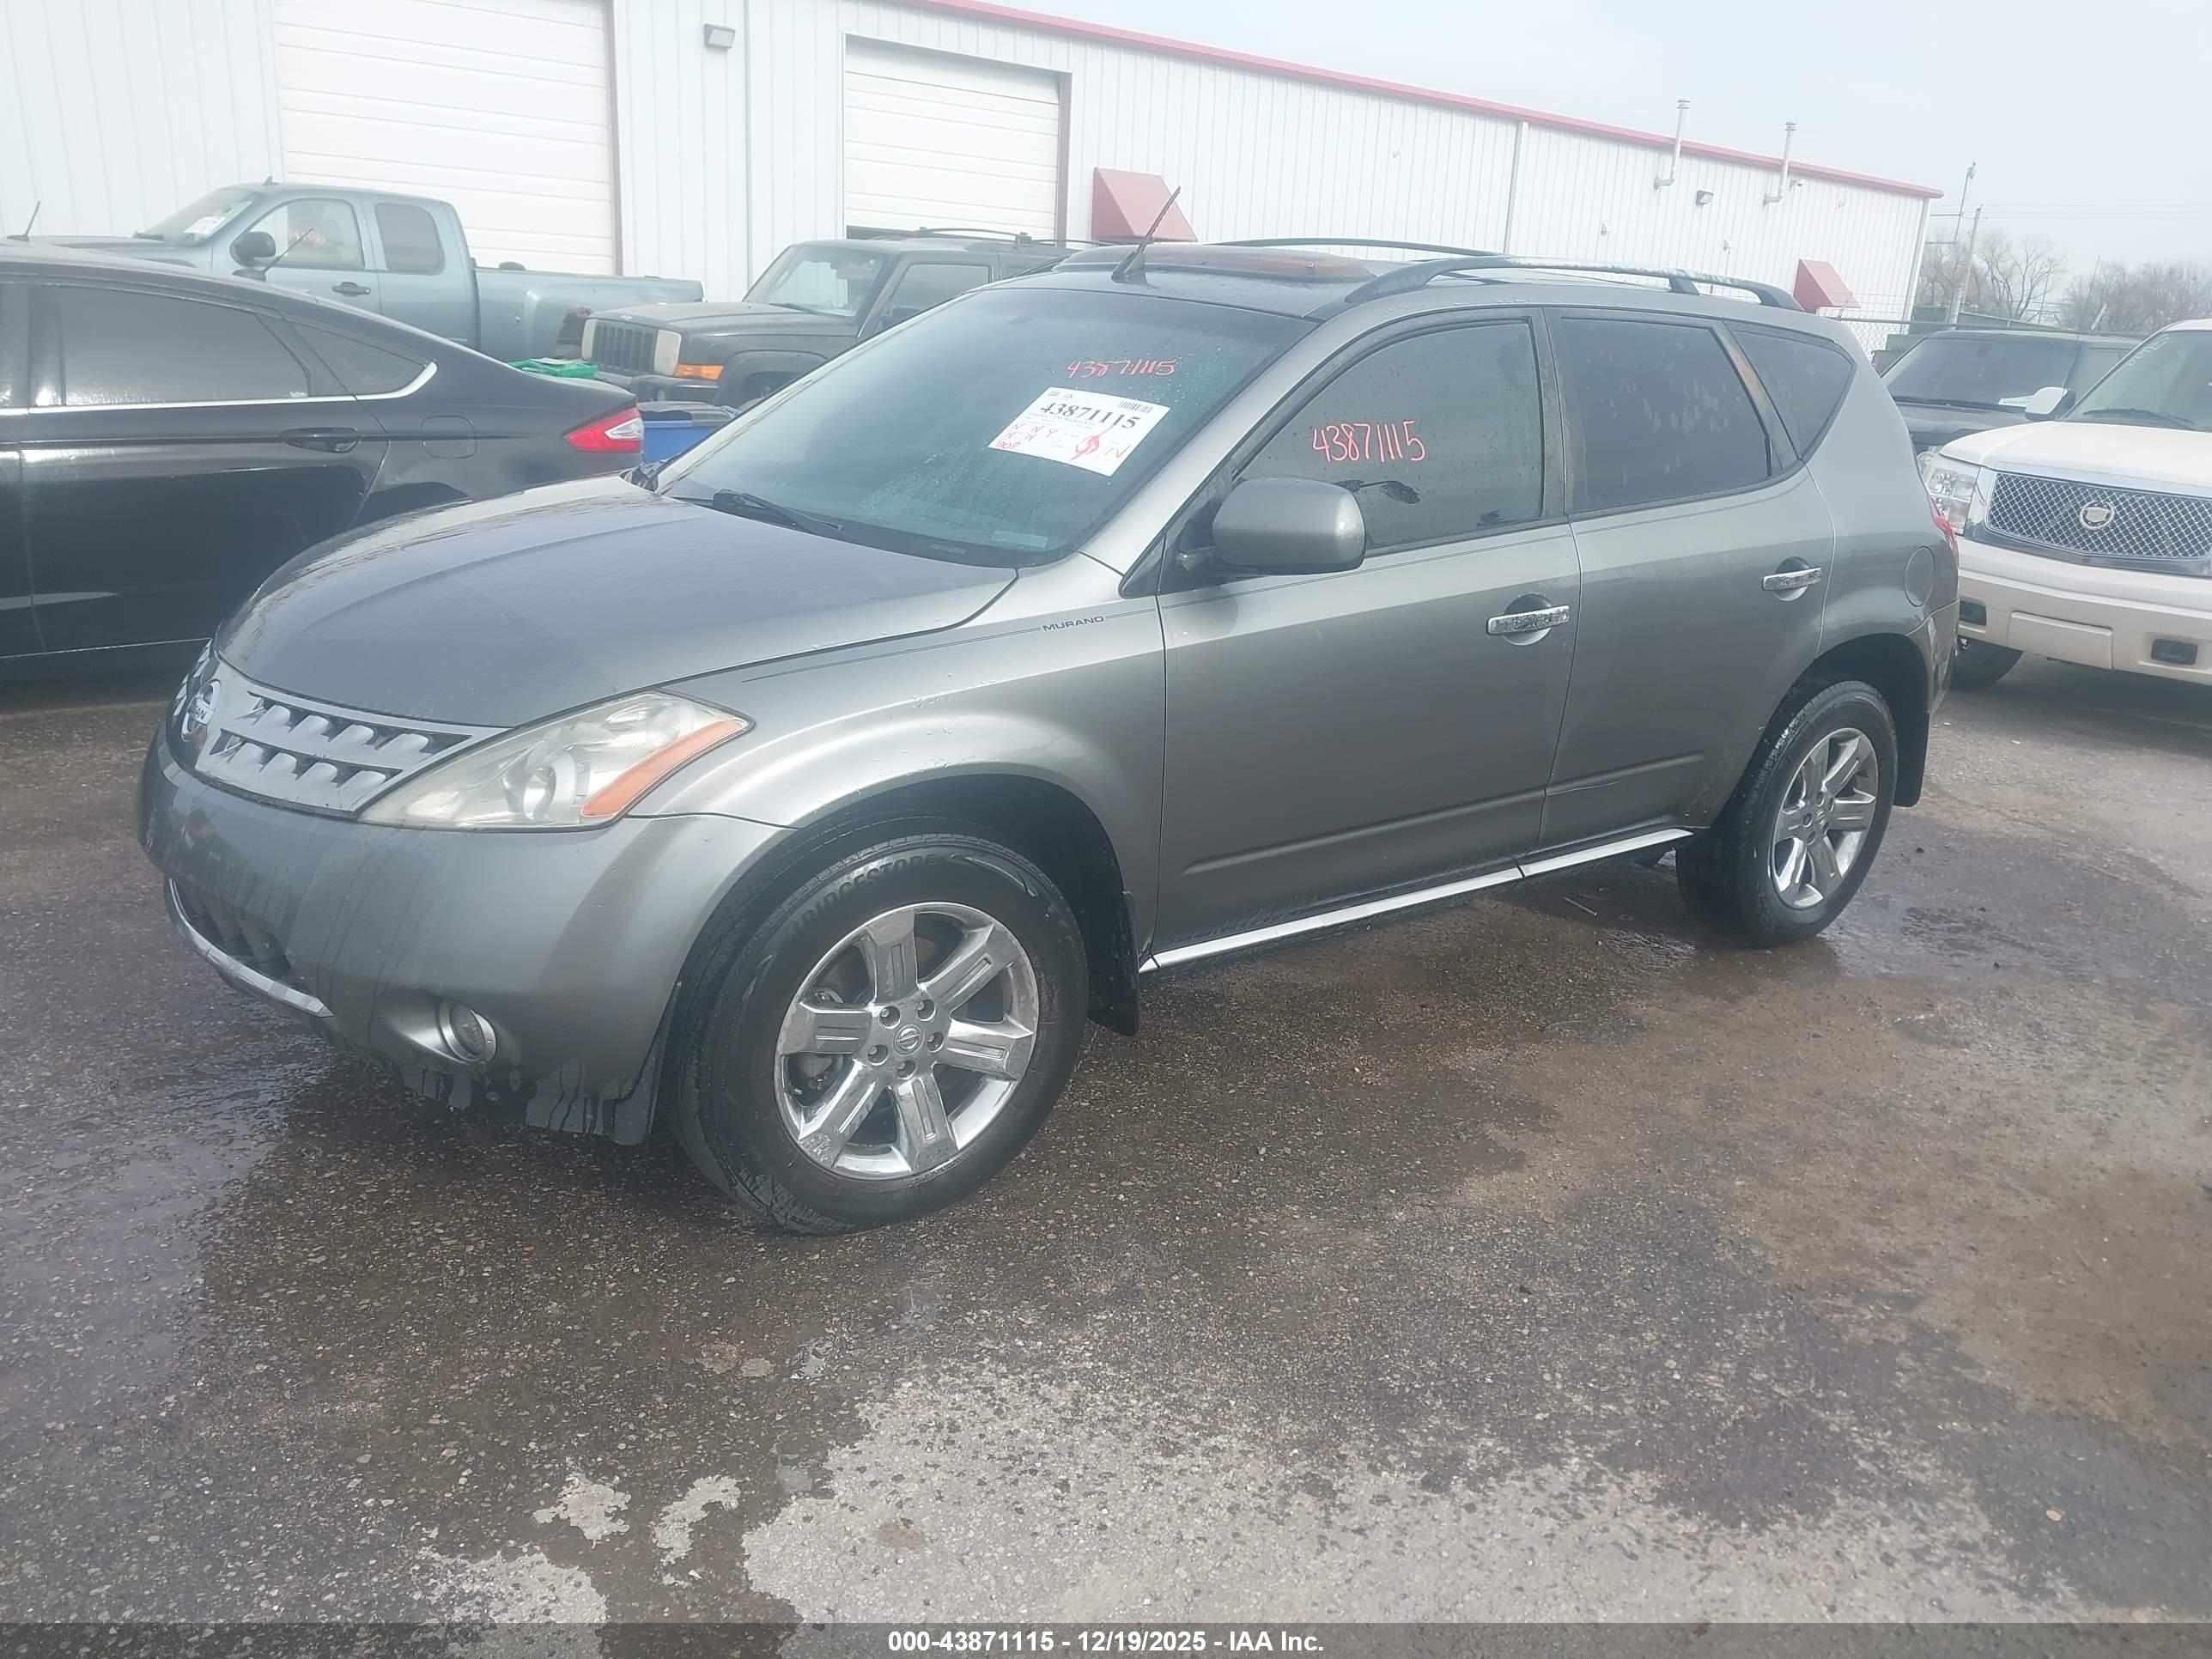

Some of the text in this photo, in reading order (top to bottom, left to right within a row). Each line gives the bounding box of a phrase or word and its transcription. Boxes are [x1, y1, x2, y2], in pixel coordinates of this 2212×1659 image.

[1040, 402, 1140, 429] 43871115
[1312, 420, 1426, 463] 43871115
[1042, 616, 1104, 631] MURANO
